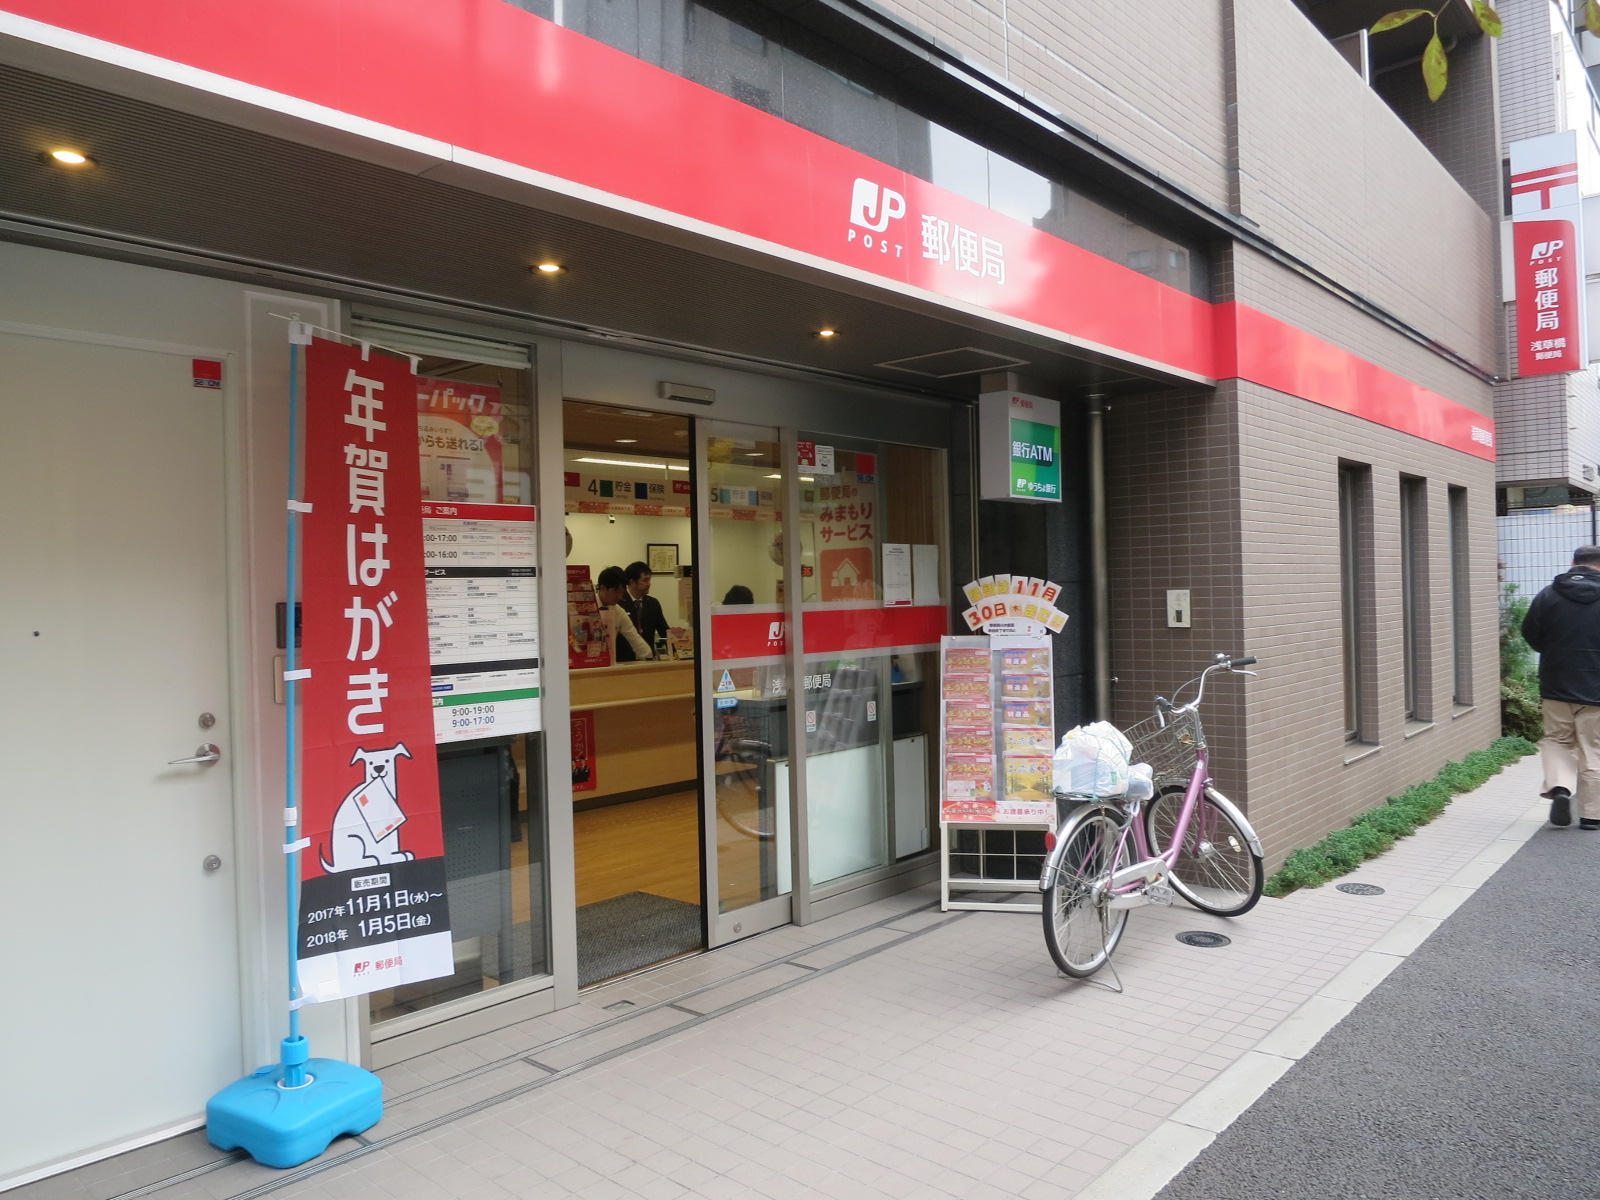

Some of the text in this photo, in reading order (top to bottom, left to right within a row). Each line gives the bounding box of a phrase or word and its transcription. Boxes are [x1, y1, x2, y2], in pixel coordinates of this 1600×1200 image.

[849, 177, 906, 233] JP
[847, 228, 903, 258] POST
[920, 213, 1006, 286] 郵便局
[1530, 239, 1564, 260] JP
[1529, 256, 1562, 266] POST
[1534, 267, 1560, 332] 郵便局
[1530, 337, 1567, 352] 浅草橋
[1012, 440, 1053, 462] 銀行ATM
[587, 479, 598, 495] 4
[614, 481, 632, 493] 貯金
[649, 483, 665, 494] 保険
[711, 488, 719, 502] 5
[1027, 482, 1057, 493] ゆうちょ銀行
[820, 502, 873, 522] みまもり
[820, 523, 873, 543] サービス
[343, 368, 398, 735] 年賀はがき
[803, 673, 832, 690] 郵便局
[451, 705, 495, 717] 9:00-19:00
[451, 716, 495, 728] 9:00-17:00
[353, 875, 388, 889] 販売期間
[306, 913, 431, 948] 2018年 1月5日(金)
[375, 956, 403, 971] 郵便局
